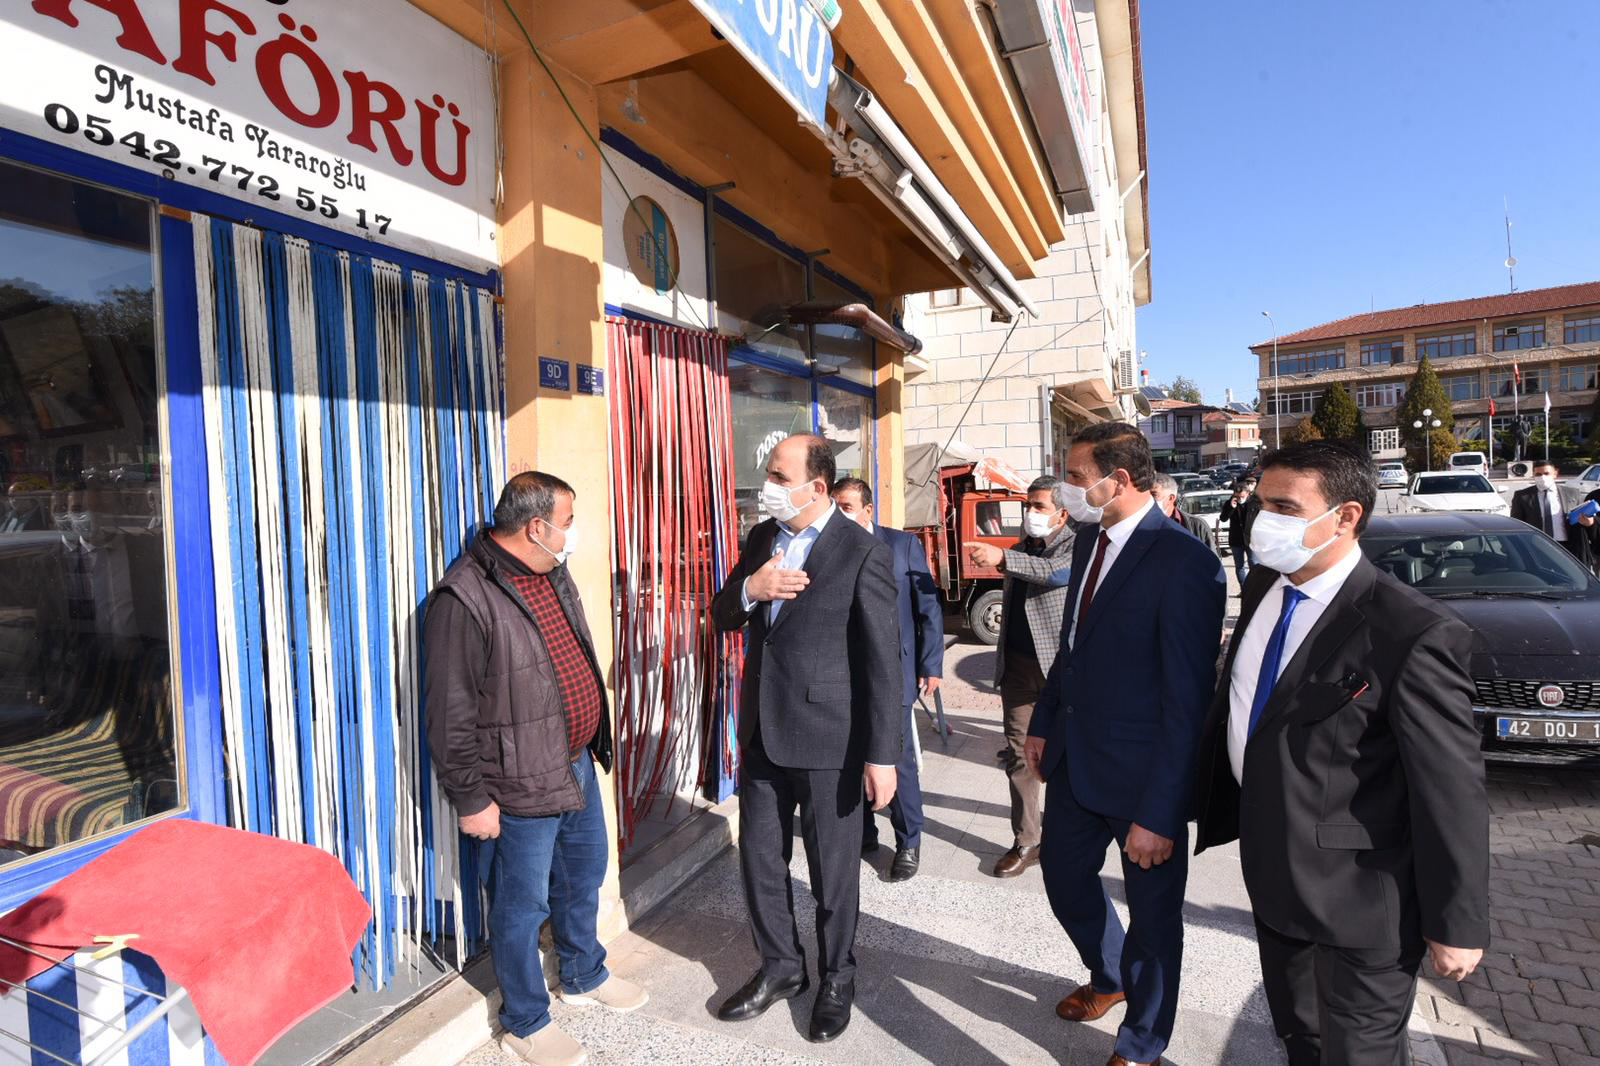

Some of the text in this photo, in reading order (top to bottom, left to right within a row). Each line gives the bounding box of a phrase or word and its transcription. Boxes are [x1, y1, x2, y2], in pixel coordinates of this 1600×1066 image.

[95, 64, 367, 192] Mustafa Yararoğlu
[44, 103, 393, 236] 0542.772 55 17
[547, 363, 562, 379] 9D
[584, 370, 597, 385] 9E
[1542, 691, 1558, 701] FIAT
[1509, 721, 1531, 736] 42
[1545, 722, 1577, 738] DOJ
